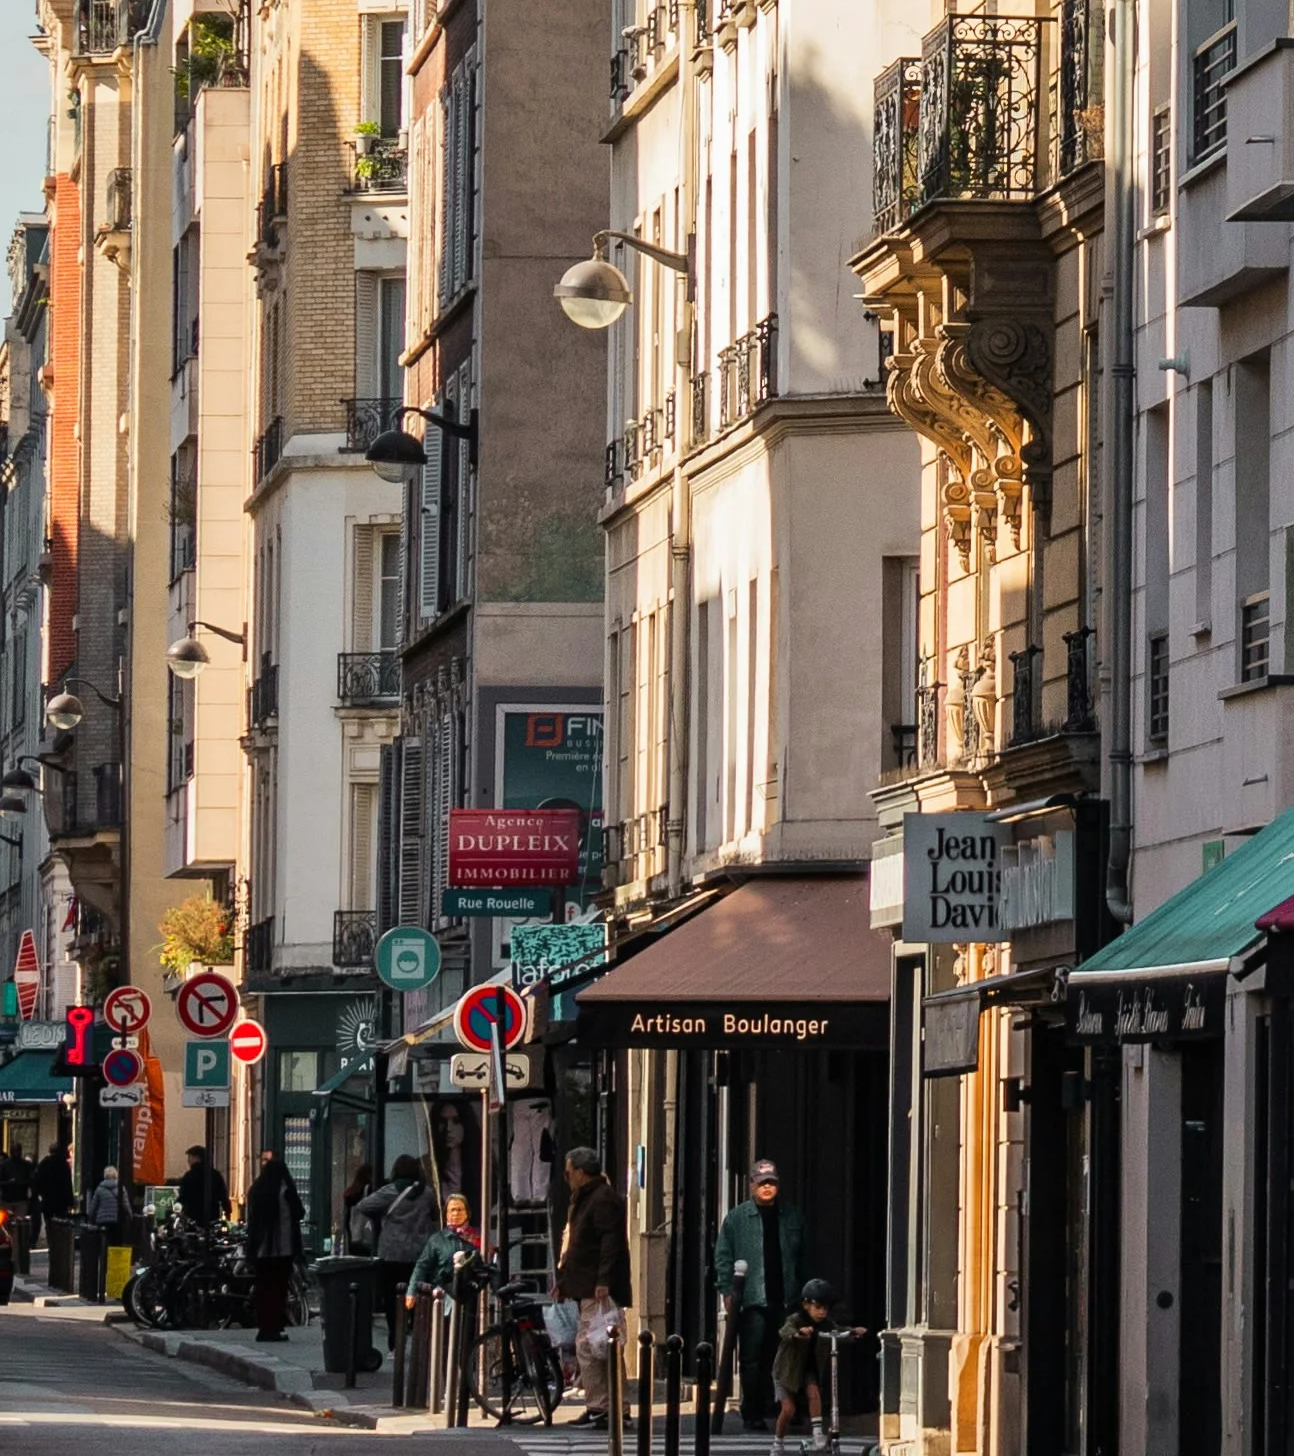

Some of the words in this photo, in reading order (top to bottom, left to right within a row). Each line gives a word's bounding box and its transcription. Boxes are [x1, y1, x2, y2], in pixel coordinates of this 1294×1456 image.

[484, 814, 544, 830] Agence
[457, 834, 570, 852] DUPLEIX
[927, 827, 996, 862] Jean
[456, 867, 571, 880] IMMOBILIER
[457, 896, 484, 910] Rue
[486, 896, 536, 910] Rouelle
[929, 894, 1001, 929] Davi
[630, 1013, 706, 1034] Artisan
[723, 1013, 829, 1041] Boulanger
